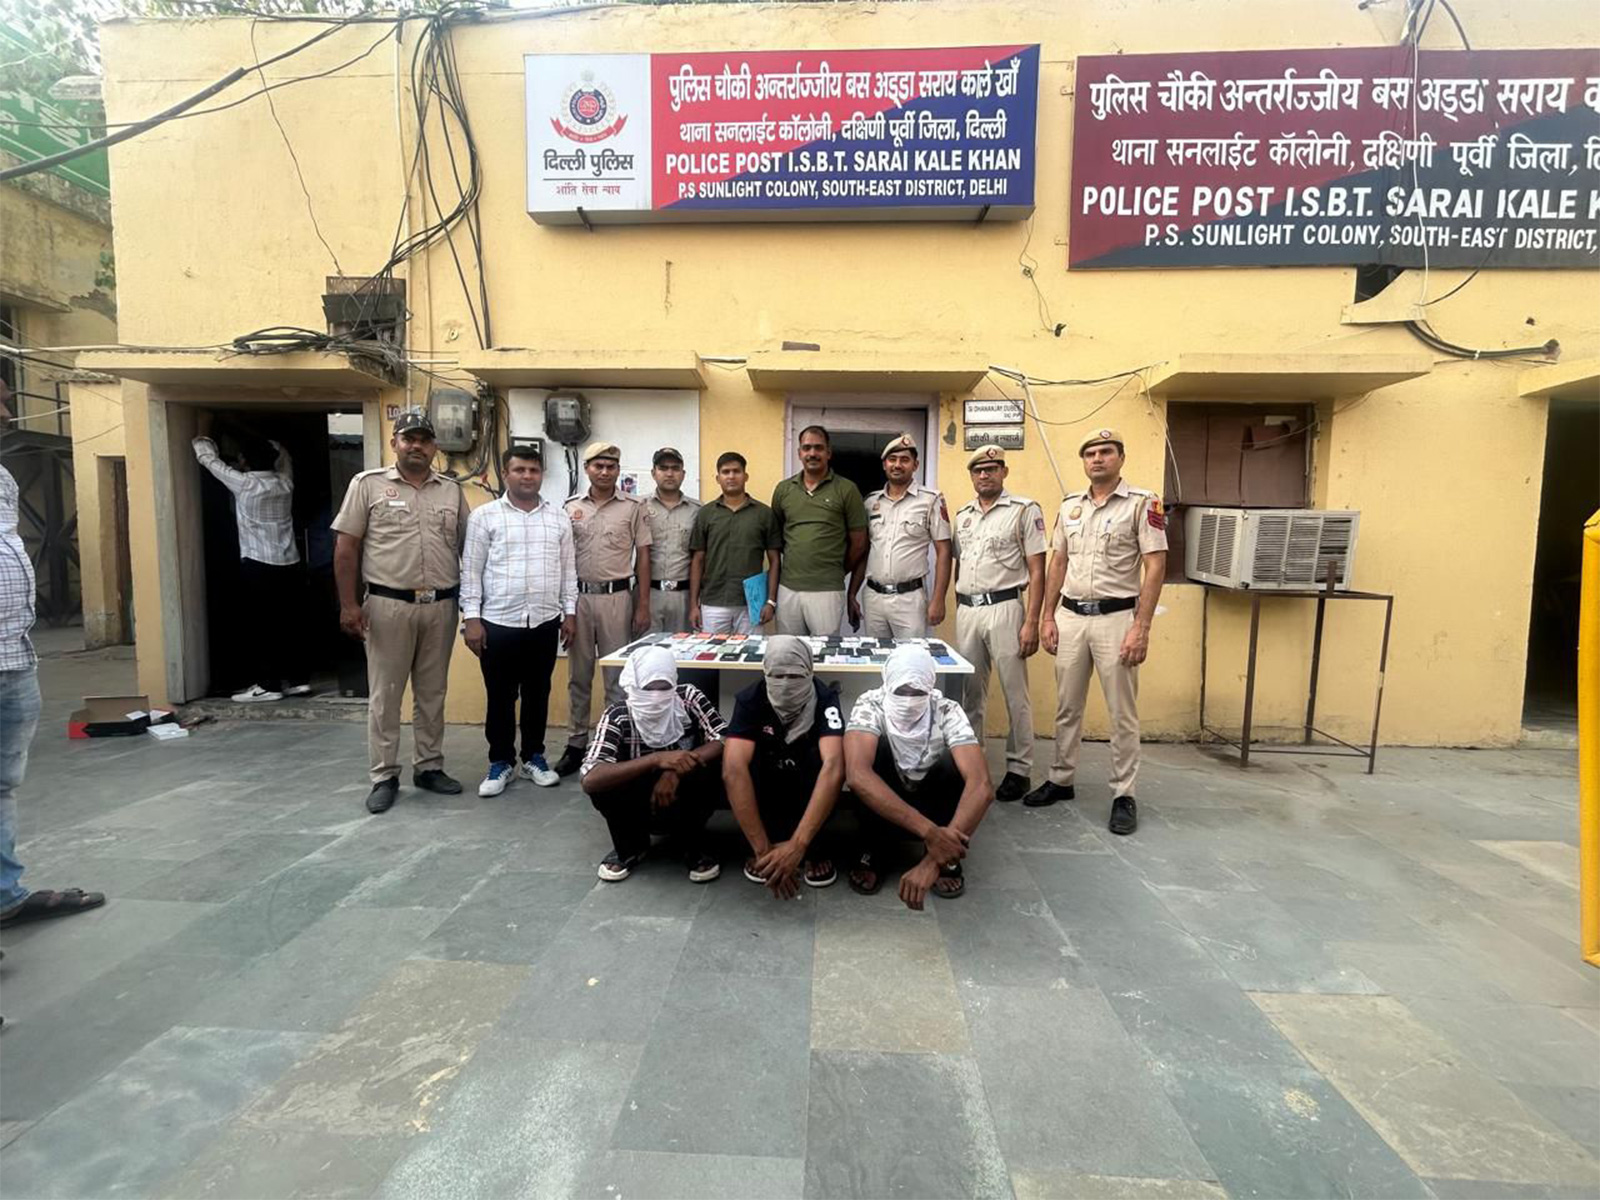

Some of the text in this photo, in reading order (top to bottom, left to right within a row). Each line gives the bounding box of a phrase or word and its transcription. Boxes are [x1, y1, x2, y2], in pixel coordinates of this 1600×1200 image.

[669, 63, 711, 112] पुलिस
[715, 62, 751, 100] चौकी
[845, 72, 871, 98] बस
[918, 70, 958, 98] सराय
[961, 60, 992, 99] काले
[995, 56, 1021, 97] खाँ
[1089, 74, 1151, 120] पुलिस
[1157, 70, 1217, 112] चौकी
[1372, 77, 1413, 110] बस
[1496, 78, 1575, 116] सराय
[680, 109, 1007, 147] थाना सनलाईट कॉलोनी, दक्षिणी पूर्वी जिला, दिल्ली
[543, 149, 634, 176] दिल्ली पुलिस
[666, 149, 1021, 174] POLICE POST I.S.B.T. SARAI KALE KHAN
[1112, 139, 1159, 165] थाना
[1166, 132, 1260, 171] सनलाईट
[1269, 130, 1355, 172] कॉलोनी,
[1361, 130, 1437, 170] दक्षिणी
[1450, 134, 1499, 177] पूर्वी
[1506, 133, 1578, 176] जिला,
[699, 181, 762, 198] SUNLIGHT
[766, 180, 819, 199] COLONY,
[822, 179, 901, 197] SOUTH-EAST
[905, 178, 966, 199] DISTRICT,
[969, 178, 1007, 195] DELHI
[1083, 186, 1179, 216] POLICE
[1192, 186, 1275, 217] POST
[1285, 187, 1373, 217] I.S.B.T.
[1385, 186, 1483, 218] SARAI
[1496, 189, 1578, 220] KALE
[1192, 224, 1294, 246] SUNLIGHT
[1303, 224, 1385, 249] COLONY,
[1389, 225, 1508, 248] SOUTH-EAST
[1515, 227, 1597, 254] DISTRICT,
[970, 432, 990, 442] चौकी
[824, 706, 842, 729] 8
